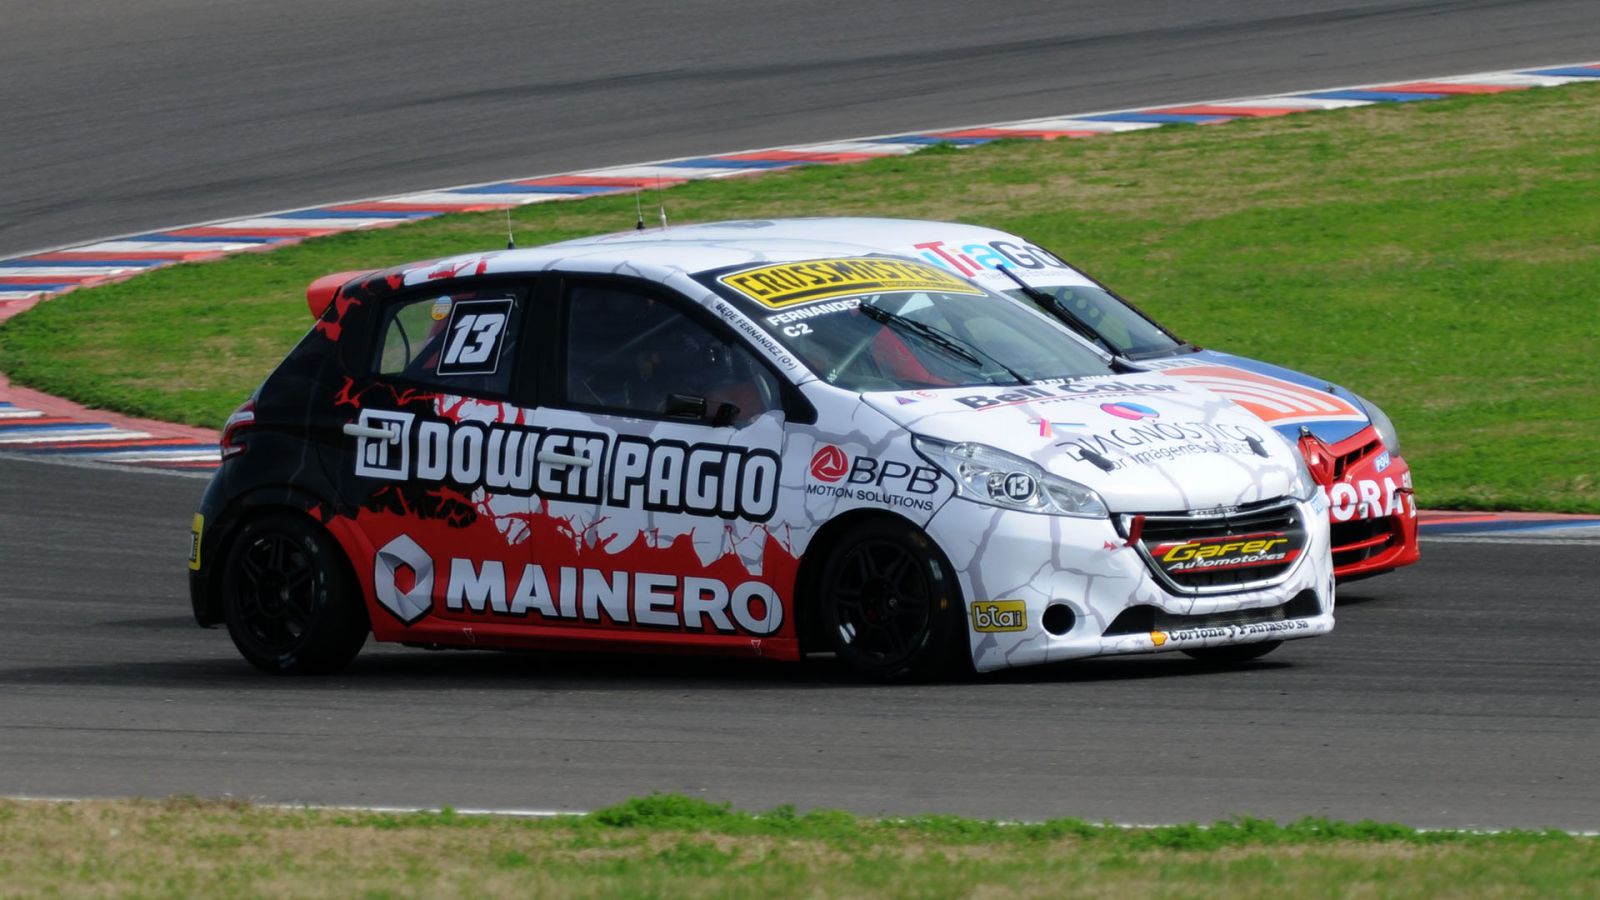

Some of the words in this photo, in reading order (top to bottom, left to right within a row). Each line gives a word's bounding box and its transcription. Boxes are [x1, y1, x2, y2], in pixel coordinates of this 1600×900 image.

[444, 313, 506, 364] 13
[736, 319, 783, 356] FERNANDEZ
[783, 322, 814, 337] C2
[954, 385, 1050, 410] Bell
[1057, 380, 1179, 394] Color
[612, 441, 778, 515] PAGIO
[847, 455, 943, 495] BPB
[1009, 475, 1029, 497] 13
[806, 483, 853, 499] MOTION
[856, 489, 934, 511] SOLUTIONS
[1167, 551, 1287, 571] Automotores
[446, 557, 784, 635] MAINERO
